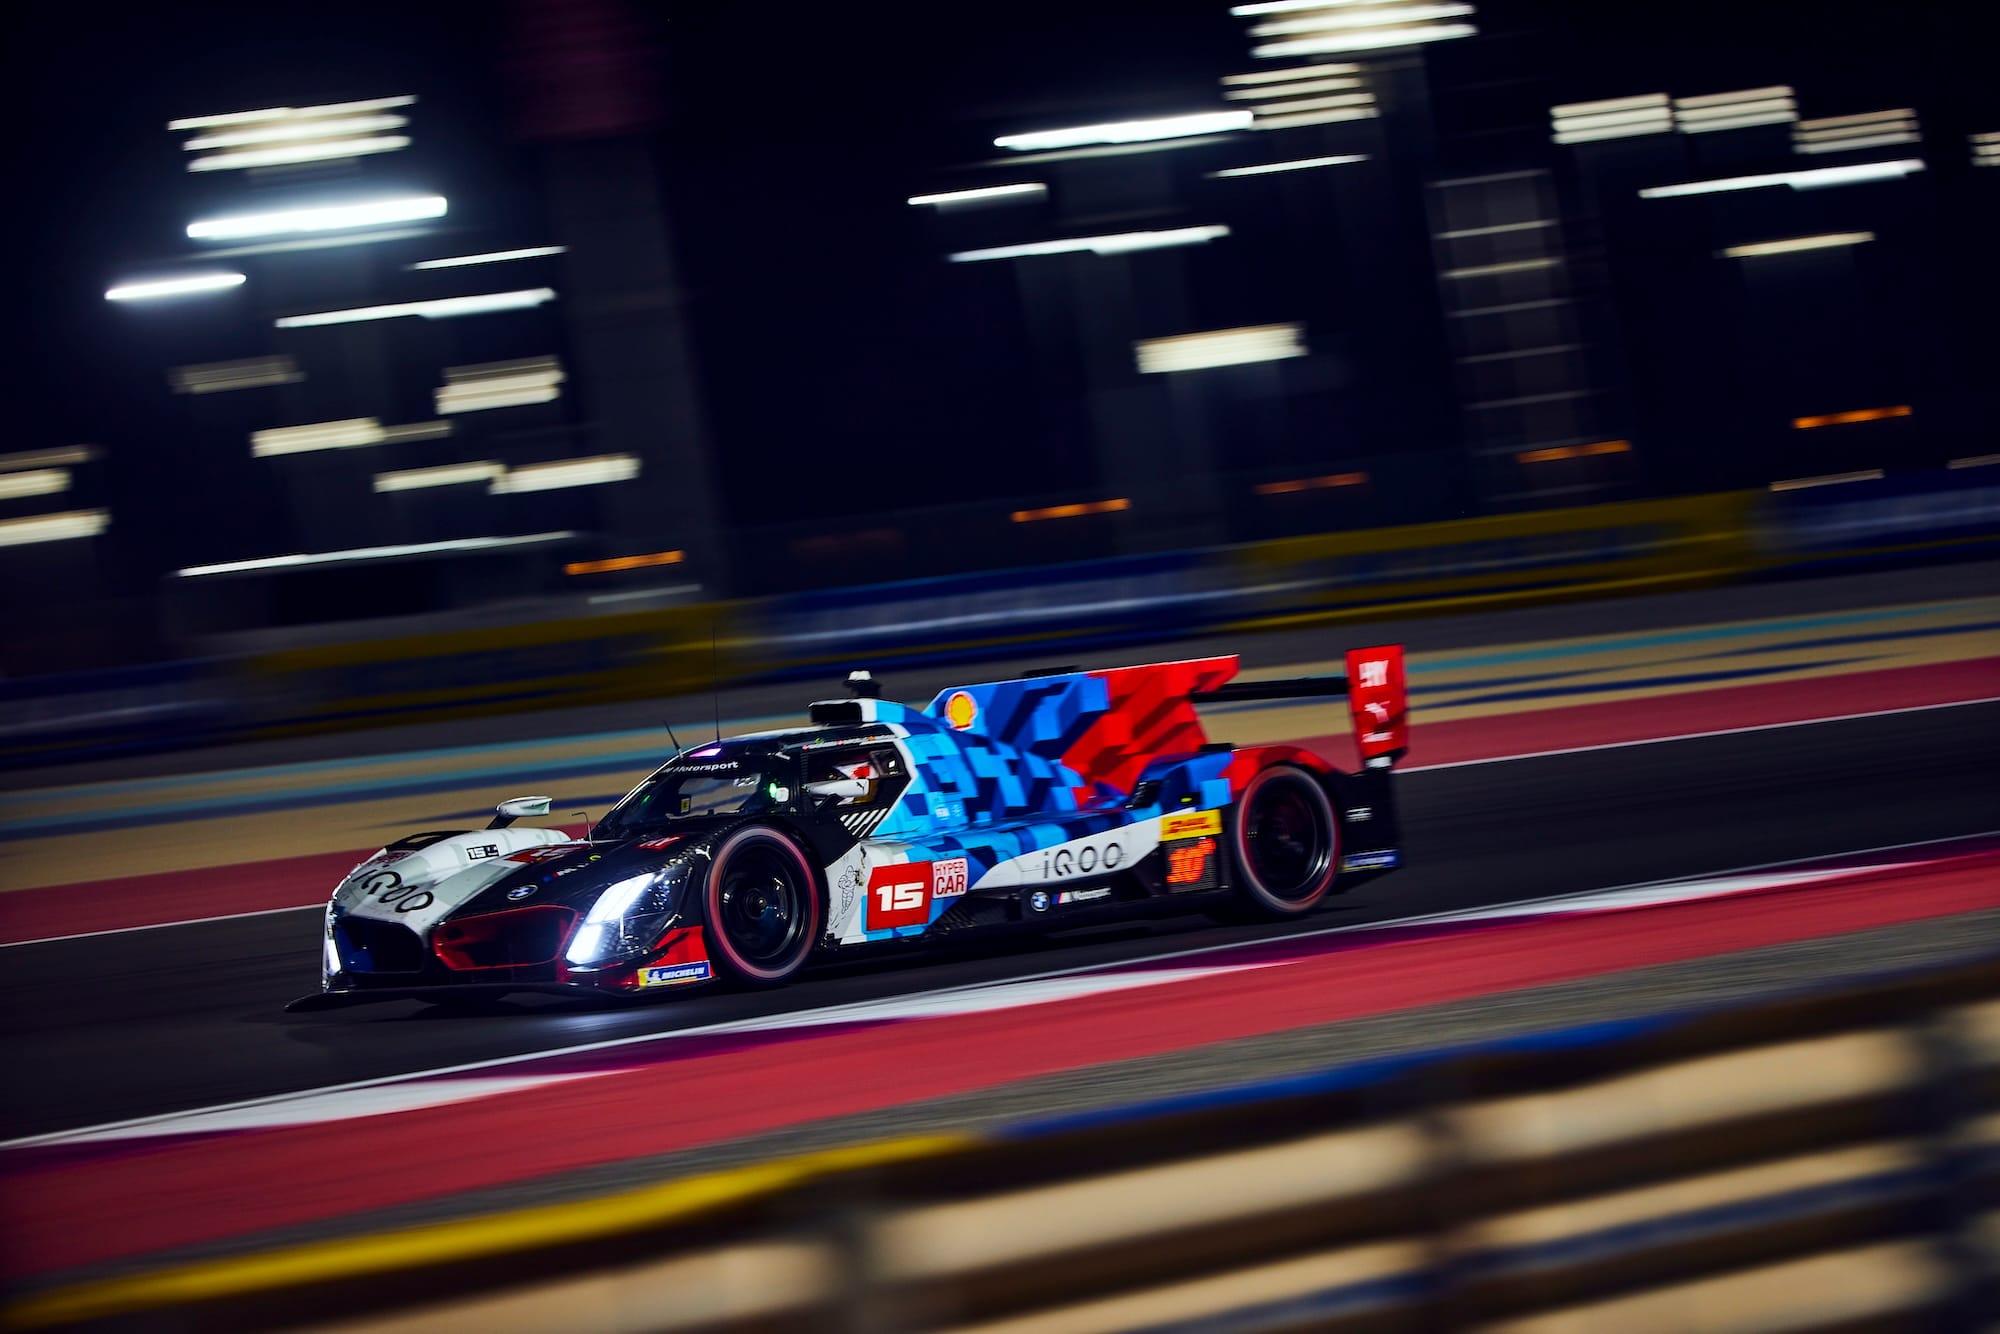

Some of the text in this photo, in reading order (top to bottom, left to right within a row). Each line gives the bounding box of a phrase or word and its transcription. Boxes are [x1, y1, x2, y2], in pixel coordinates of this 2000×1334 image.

[467, 847, 487, 859] 15
[1043, 842, 1123, 879] iQOO
[935, 861, 966, 876] HYPER
[936, 873, 965, 895] CAR
[875, 881, 925, 912] 15
[661, 967, 705, 980] MICHELIN
